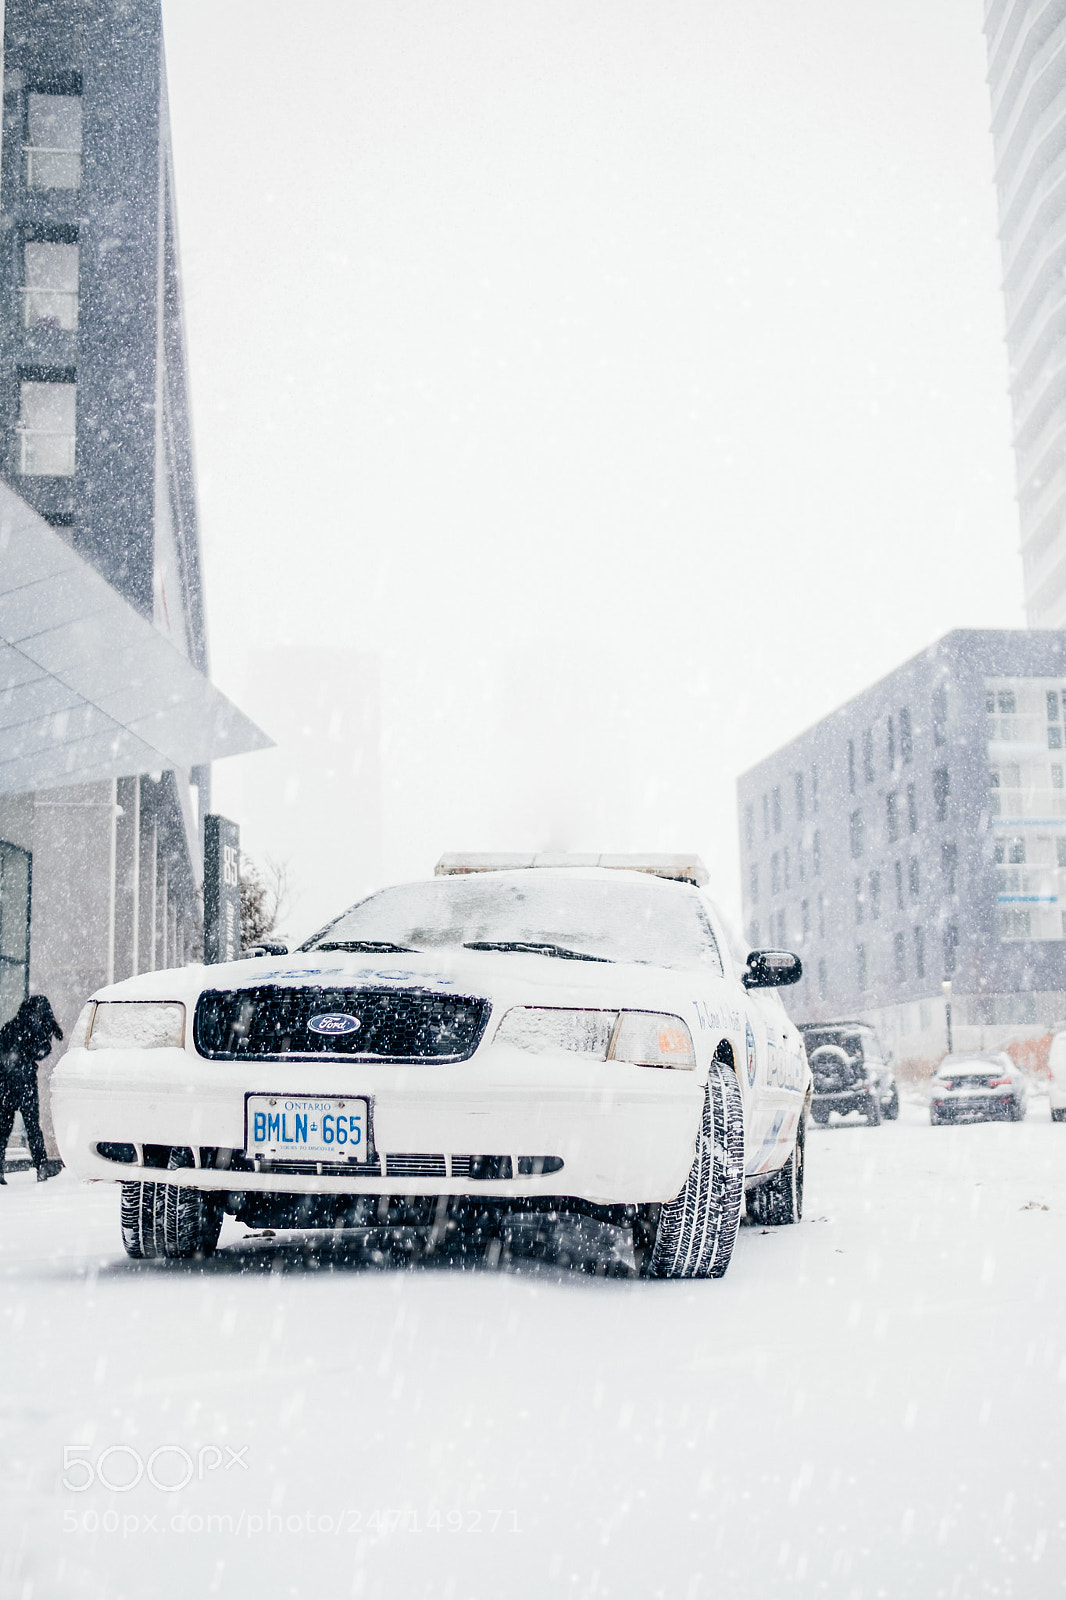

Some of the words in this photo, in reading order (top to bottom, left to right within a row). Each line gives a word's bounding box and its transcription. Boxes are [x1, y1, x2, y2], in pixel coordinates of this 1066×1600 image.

[223, 844, 237, 887] 85
[319, 1016, 347, 1029] Ford
[284, 1101, 332, 1111] ONTARIO
[254, 1112, 308, 1143] BMLN
[322, 1114, 361, 1145] 665
